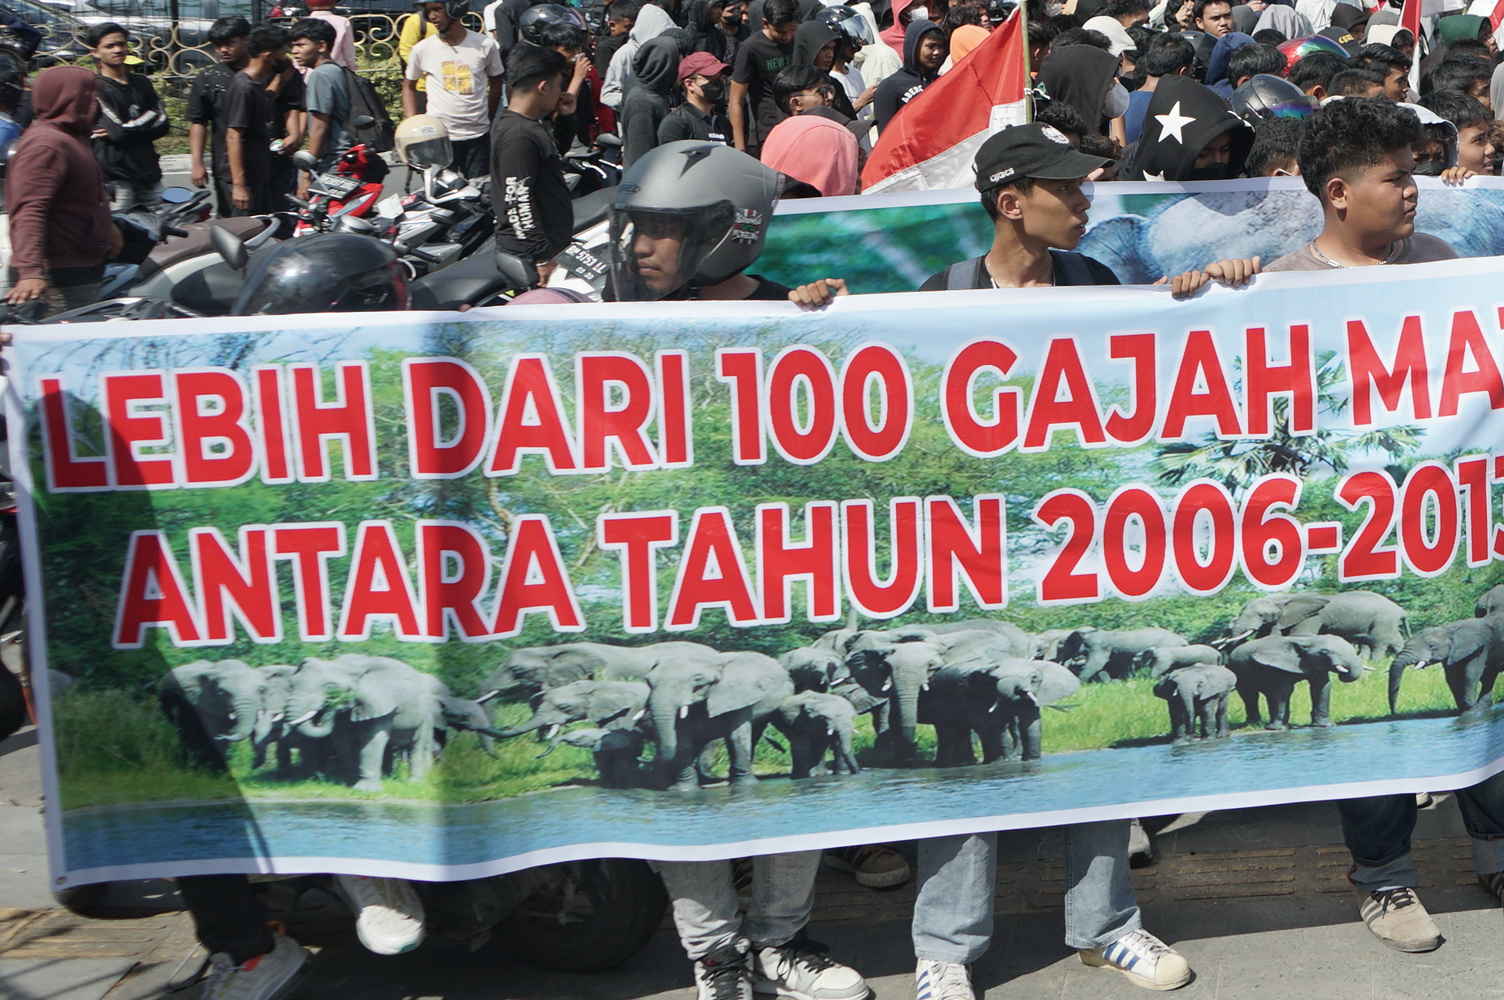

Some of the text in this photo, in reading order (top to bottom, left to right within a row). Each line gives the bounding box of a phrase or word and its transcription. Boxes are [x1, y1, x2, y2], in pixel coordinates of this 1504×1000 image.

[39, 361, 376, 491] LEBIH
[406, 350, 691, 477] DARI
[717, 344, 910, 463] 100
[941, 323, 1318, 457] GAJAH
[115, 514, 583, 648] ANTARA
[600, 494, 1007, 632] TAHUN
